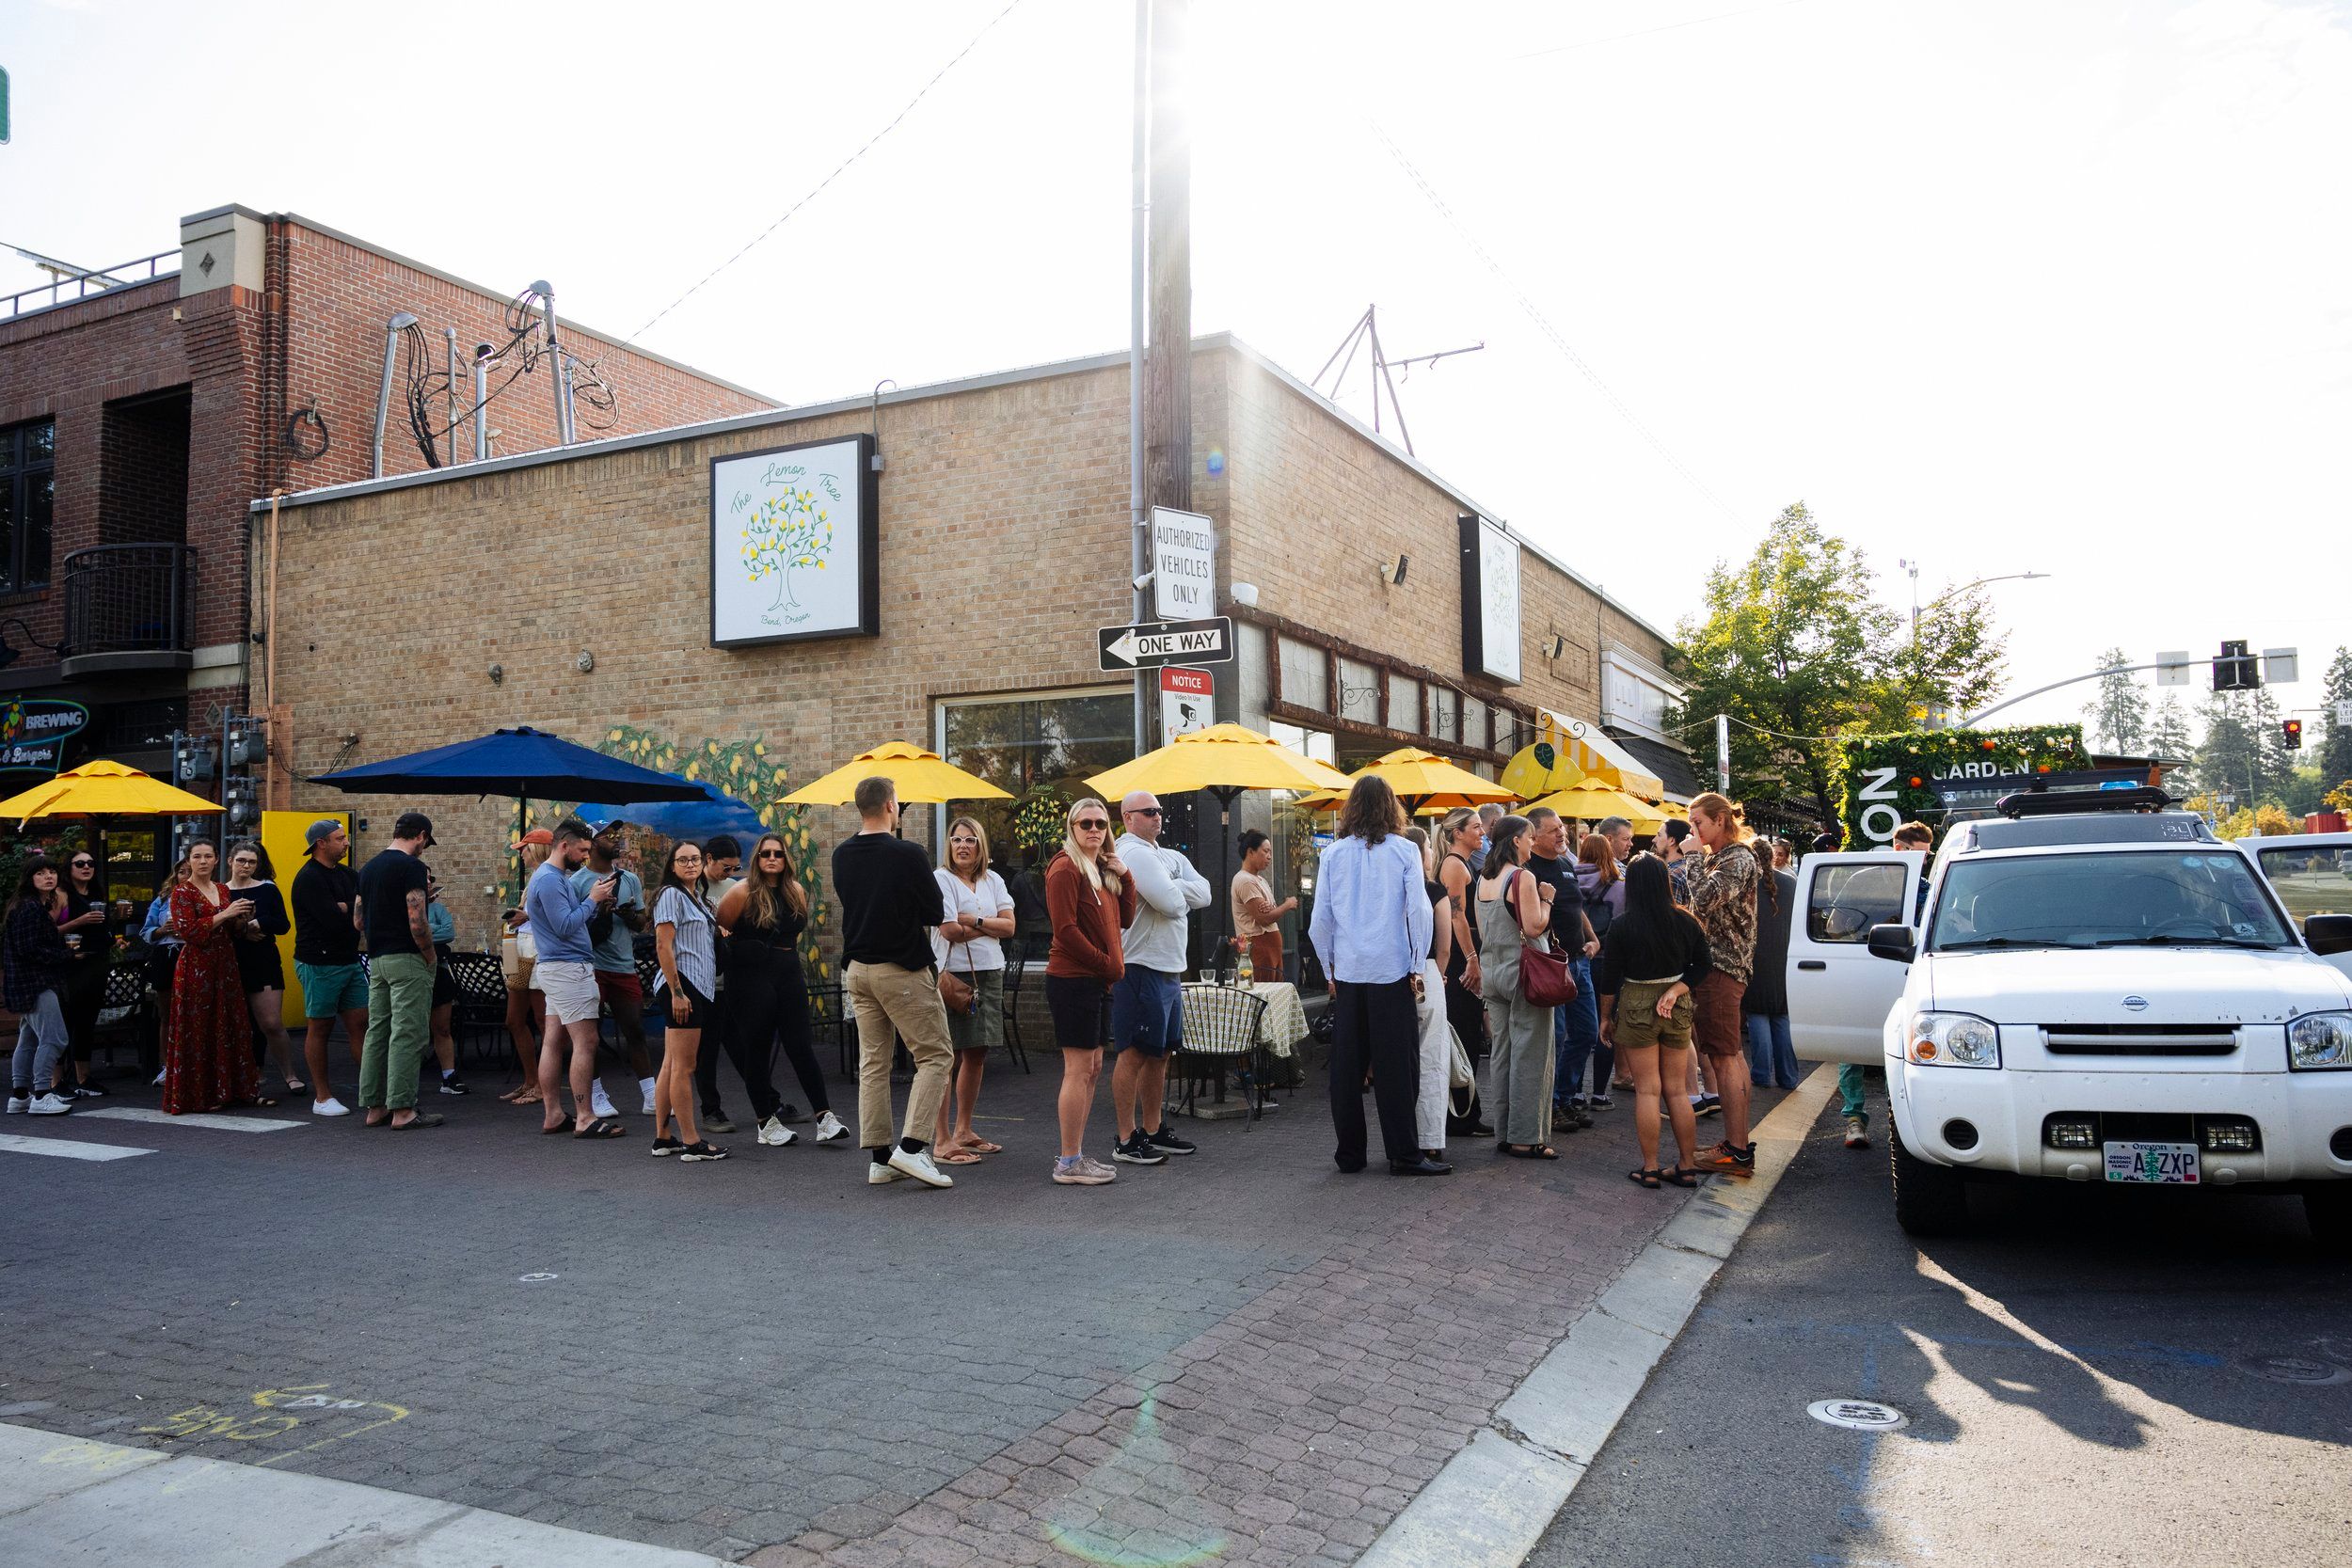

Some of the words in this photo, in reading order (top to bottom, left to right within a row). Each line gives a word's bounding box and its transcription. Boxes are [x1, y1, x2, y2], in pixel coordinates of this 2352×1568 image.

[730, 490, 752, 514] The
[760, 462, 807, 486] Lemon
[818, 473, 841, 502] Tree
[1156, 525, 1210, 552] AUTHORIZED
[1160, 554, 1209, 578] VEHICLES
[1172, 583, 1199, 605] ONLY
[1138, 636, 1173, 655] ONE
[1180, 631, 1216, 651] WAY
[1171, 674, 1202, 689] NOTICE
[25, 711, 82, 729] BREWING
[11, 747, 53, 766] Burgers
[1931, 760, 2029, 780] GARDEN
[1026, 782, 1055, 797] Lemon
[1061, 791, 1074, 806] Tre
[2132, 1143, 2168, 1152] Oregon
